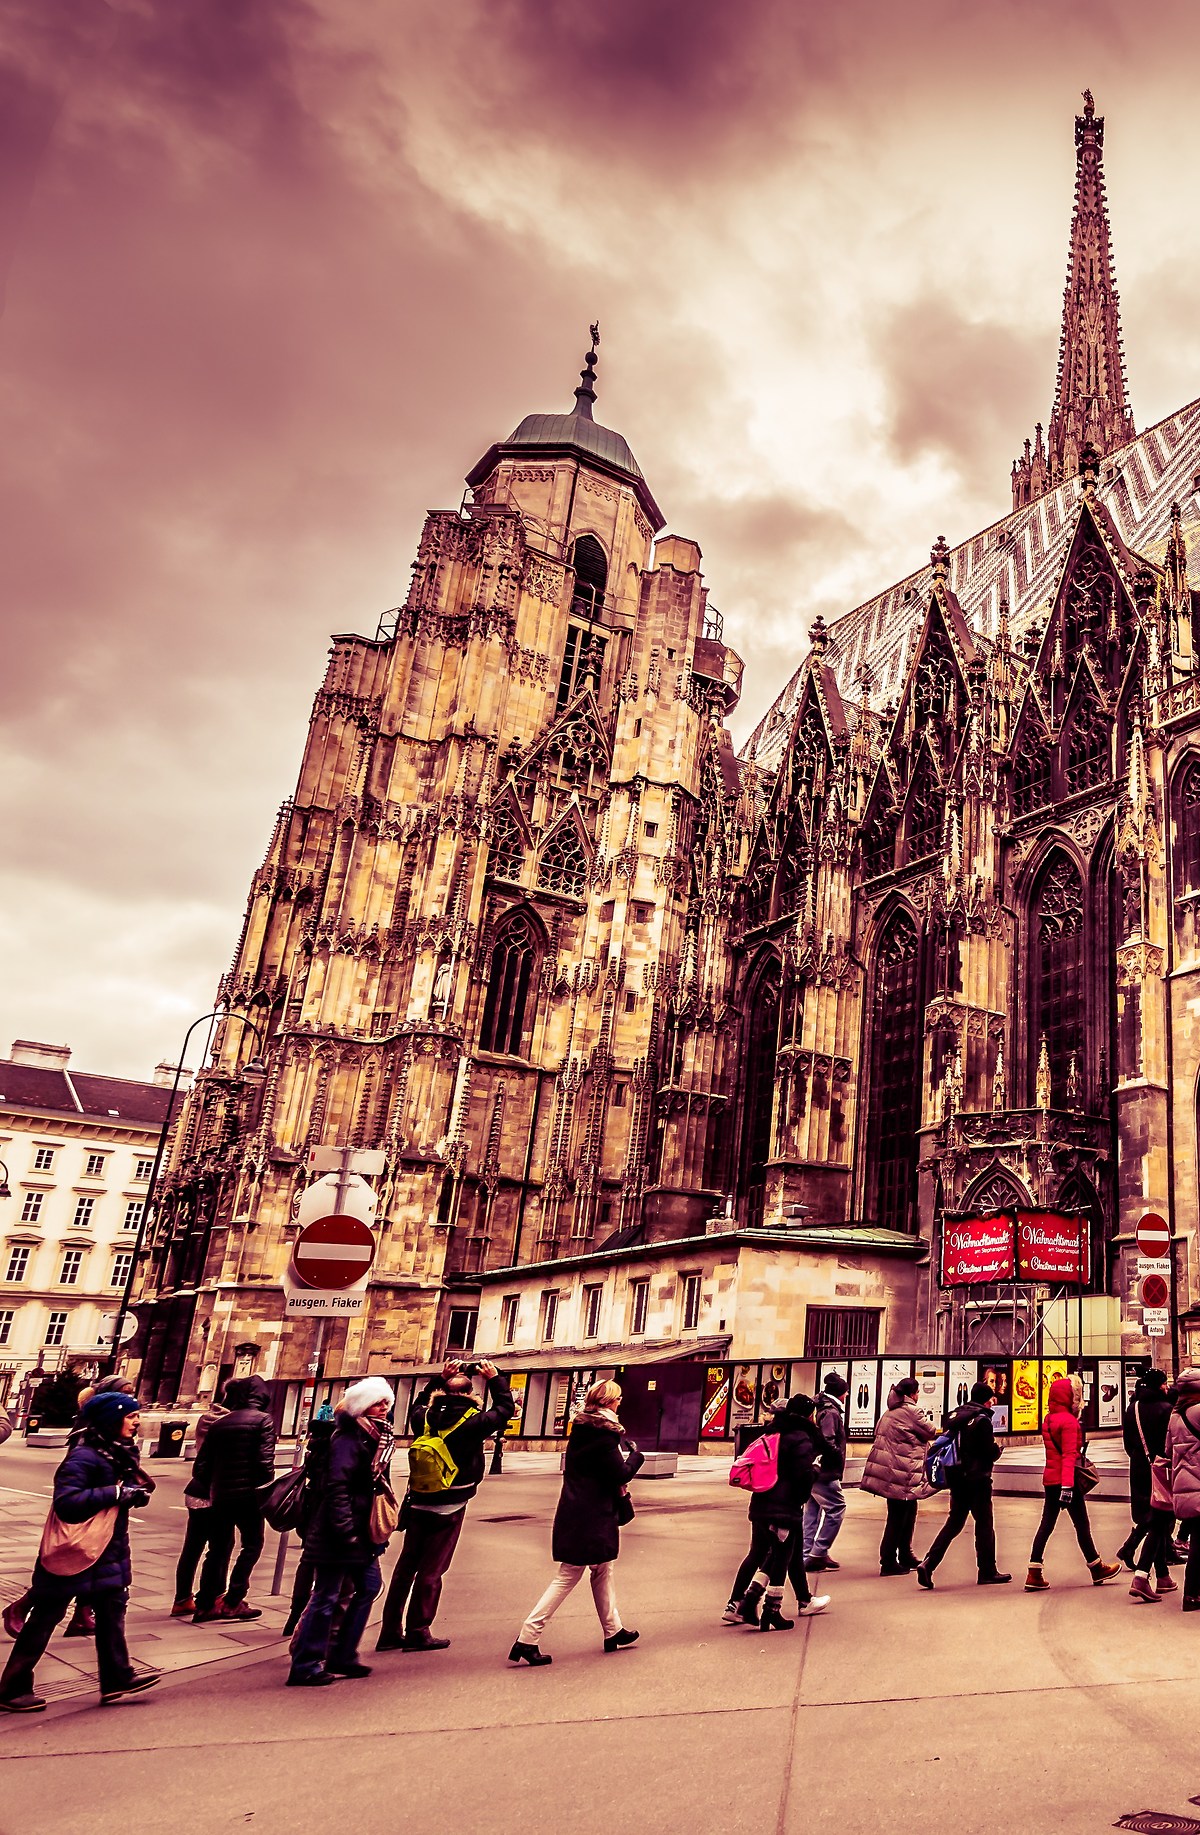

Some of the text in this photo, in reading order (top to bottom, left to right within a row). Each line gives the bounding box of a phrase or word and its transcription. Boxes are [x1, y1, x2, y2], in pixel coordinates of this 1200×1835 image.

[950, 1230, 1010, 1251] Weihnachtsmarkt
[957, 1260, 982, 1275] Christmas
[1030, 1255, 1057, 1271] Christmas
[289, 1297, 362, 1309] ausgen. Fiaker
